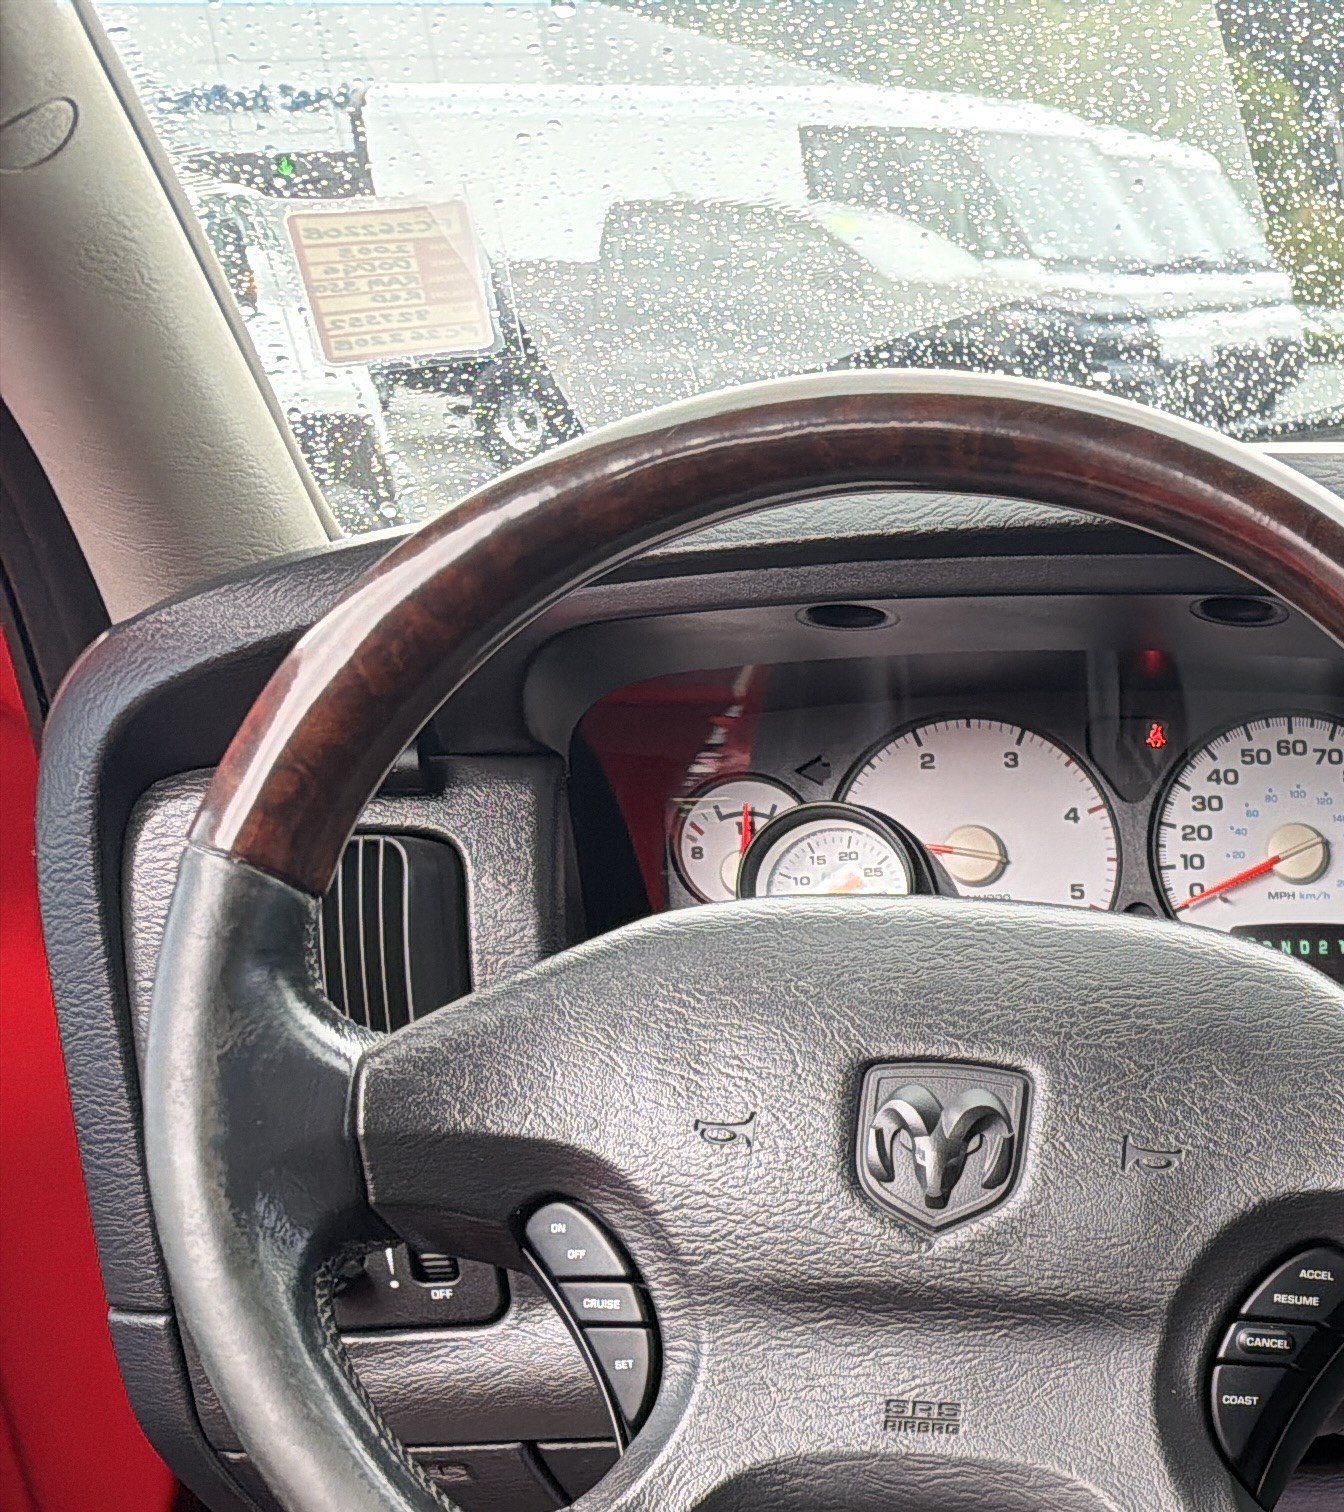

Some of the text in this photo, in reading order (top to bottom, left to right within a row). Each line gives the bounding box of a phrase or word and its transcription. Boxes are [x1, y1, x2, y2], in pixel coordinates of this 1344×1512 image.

[1276, 739, 1308, 757] 60
[920, 753, 936, 770] 2
[1003, 751, 1019, 769] 3
[1240, 748, 1272, 766] 50
[1312, 748, 1344, 766] 70
[1206, 768, 1239, 786] 40
[1191, 795, 1224, 812] 30
[1064, 807, 1080, 824] 4
[1181, 824, 1213, 842] 20
[691, 845, 704, 860] 8
[838, 851, 859, 863] 20
[809, 854, 828, 866] 15
[1179, 853, 1206, 871] 10
[862, 866, 884, 879] 25
[792, 875, 811, 887] 10
[1070, 883, 1085, 901] 5
[1267, 890, 1331, 901] MPH km/h
[550, 1223, 566, 1234] ON
[567, 1249, 586, 1260] OFF
[1299, 1269, 1335, 1282] ACCEL
[430, 1289, 454, 1300] OFF
[1273, 1293, 1321, 1307] RESUME
[582, 1299, 621, 1309] CRUISE
[1246, 1337, 1291, 1350] CANCEL
[614, 1359, 634, 1370] SET
[1222, 1394, 1260, 1406] COAST
[885, 1399, 961, 1417] SRS
[883, 1419, 961, 1435] AIRBAG
